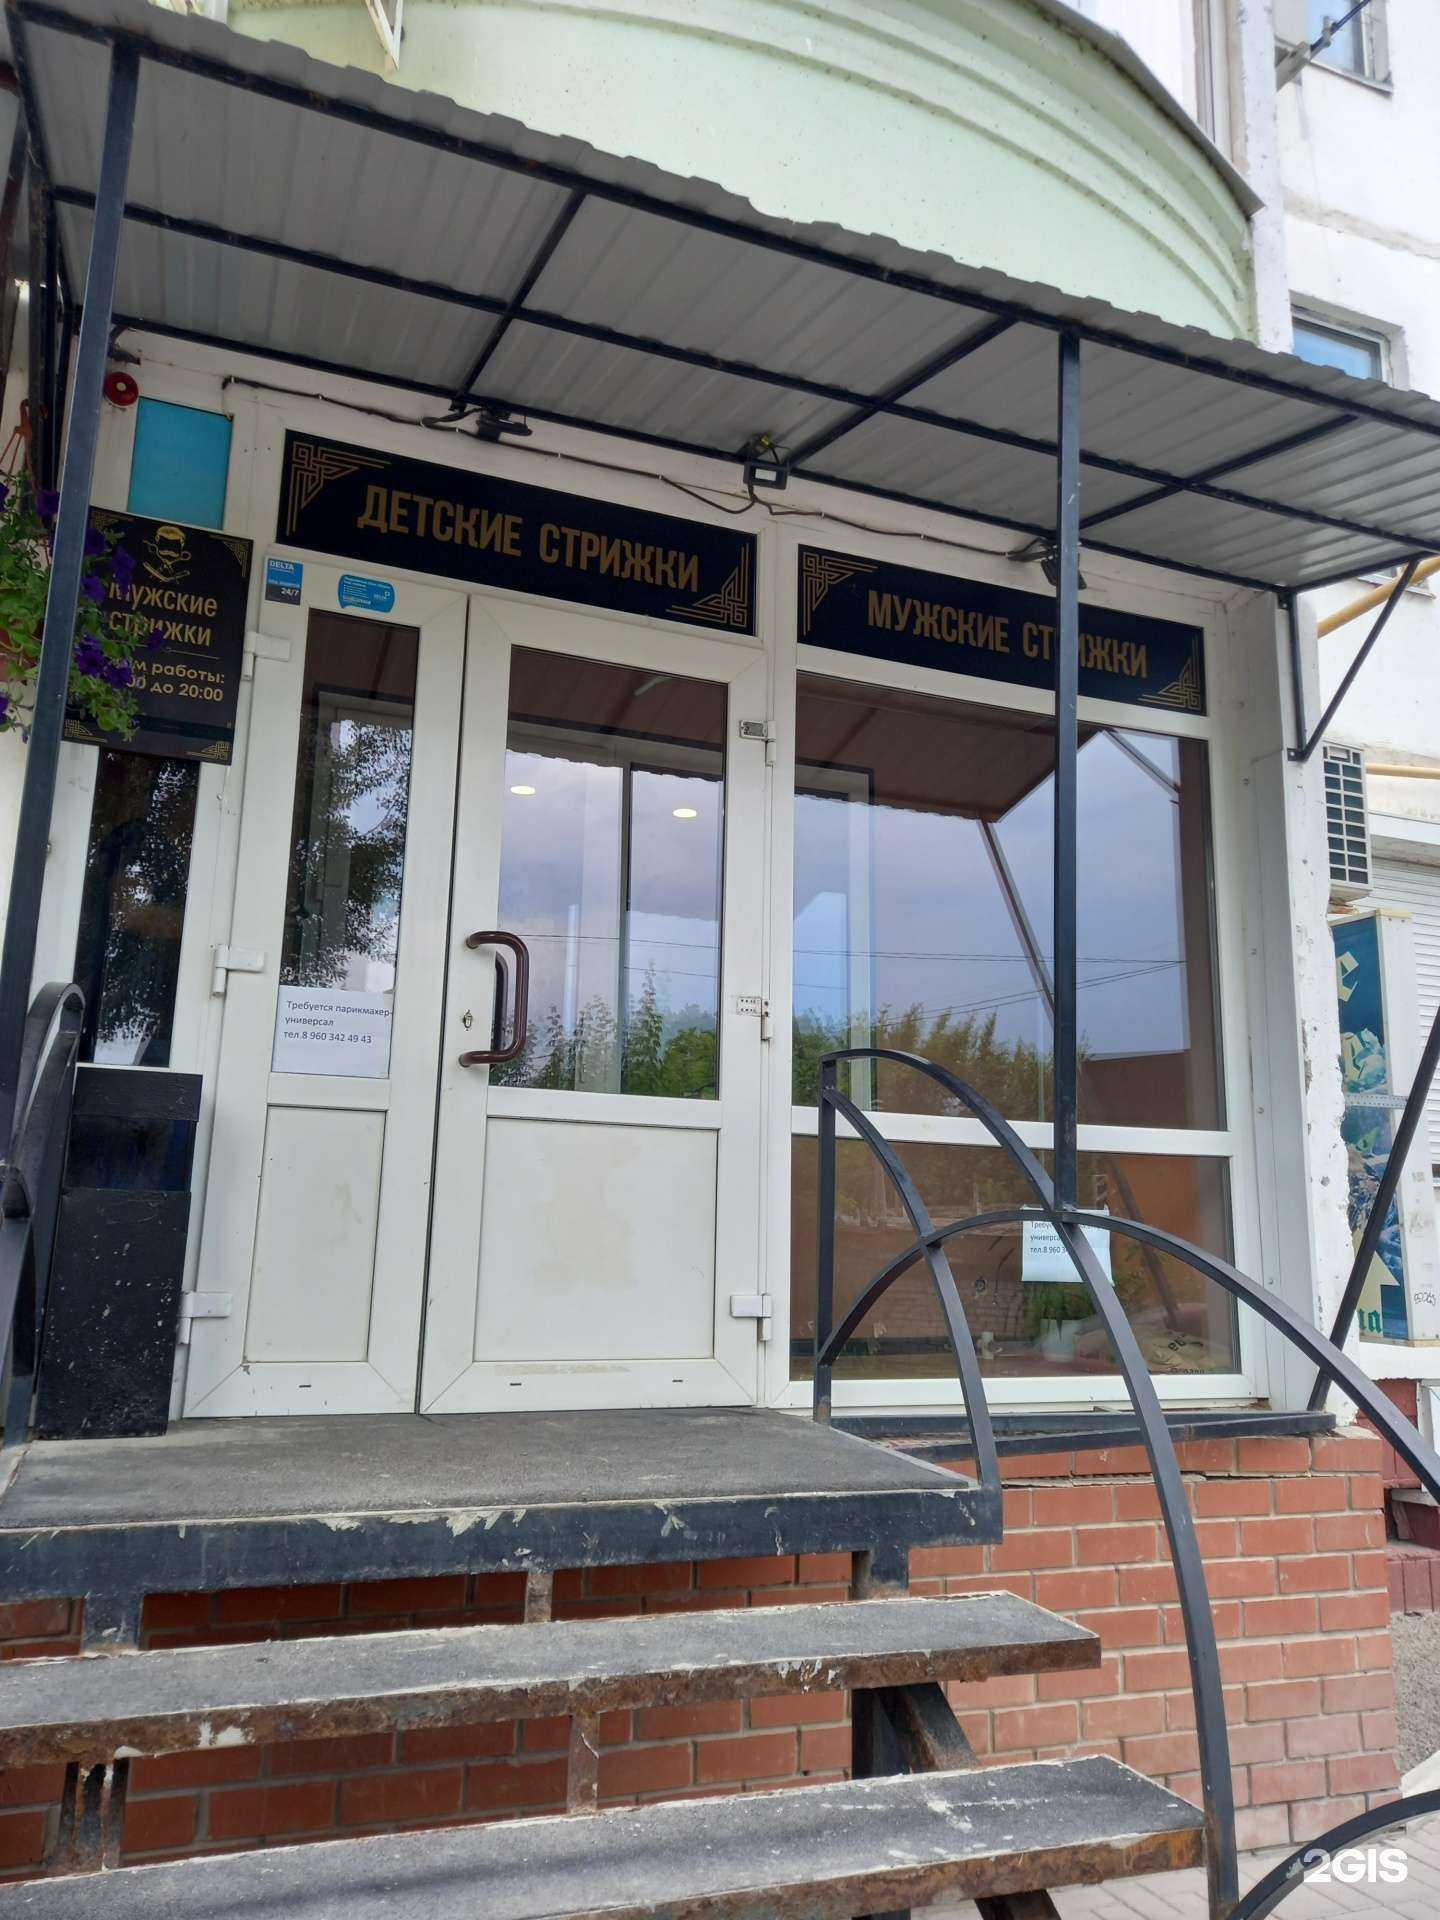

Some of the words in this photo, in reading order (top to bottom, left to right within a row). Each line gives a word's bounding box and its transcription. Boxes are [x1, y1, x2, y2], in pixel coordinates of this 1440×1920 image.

[356, 484, 523, 557] ДЕТСКИЕ
[538, 522, 699, 593] СТРИЖКИ
[270, 560, 295, 571] DELTA
[281, 587, 300, 597] 24/7
[867, 590, 1010, 653] МУЖСКИЕ
[152, 663, 225, 684] работы:
[150, 682, 175, 694] до
[178, 683, 224, 701] 20:00
[286, 1000, 334, 1012] Требуется
[284, 1016, 334, 1027] универсал
[310, 1031, 327, 1041] 960
[329, 1033, 345, 1042] 342
[347, 1034, 359, 1043] 49
[360, 1035, 372, 1044] 43
